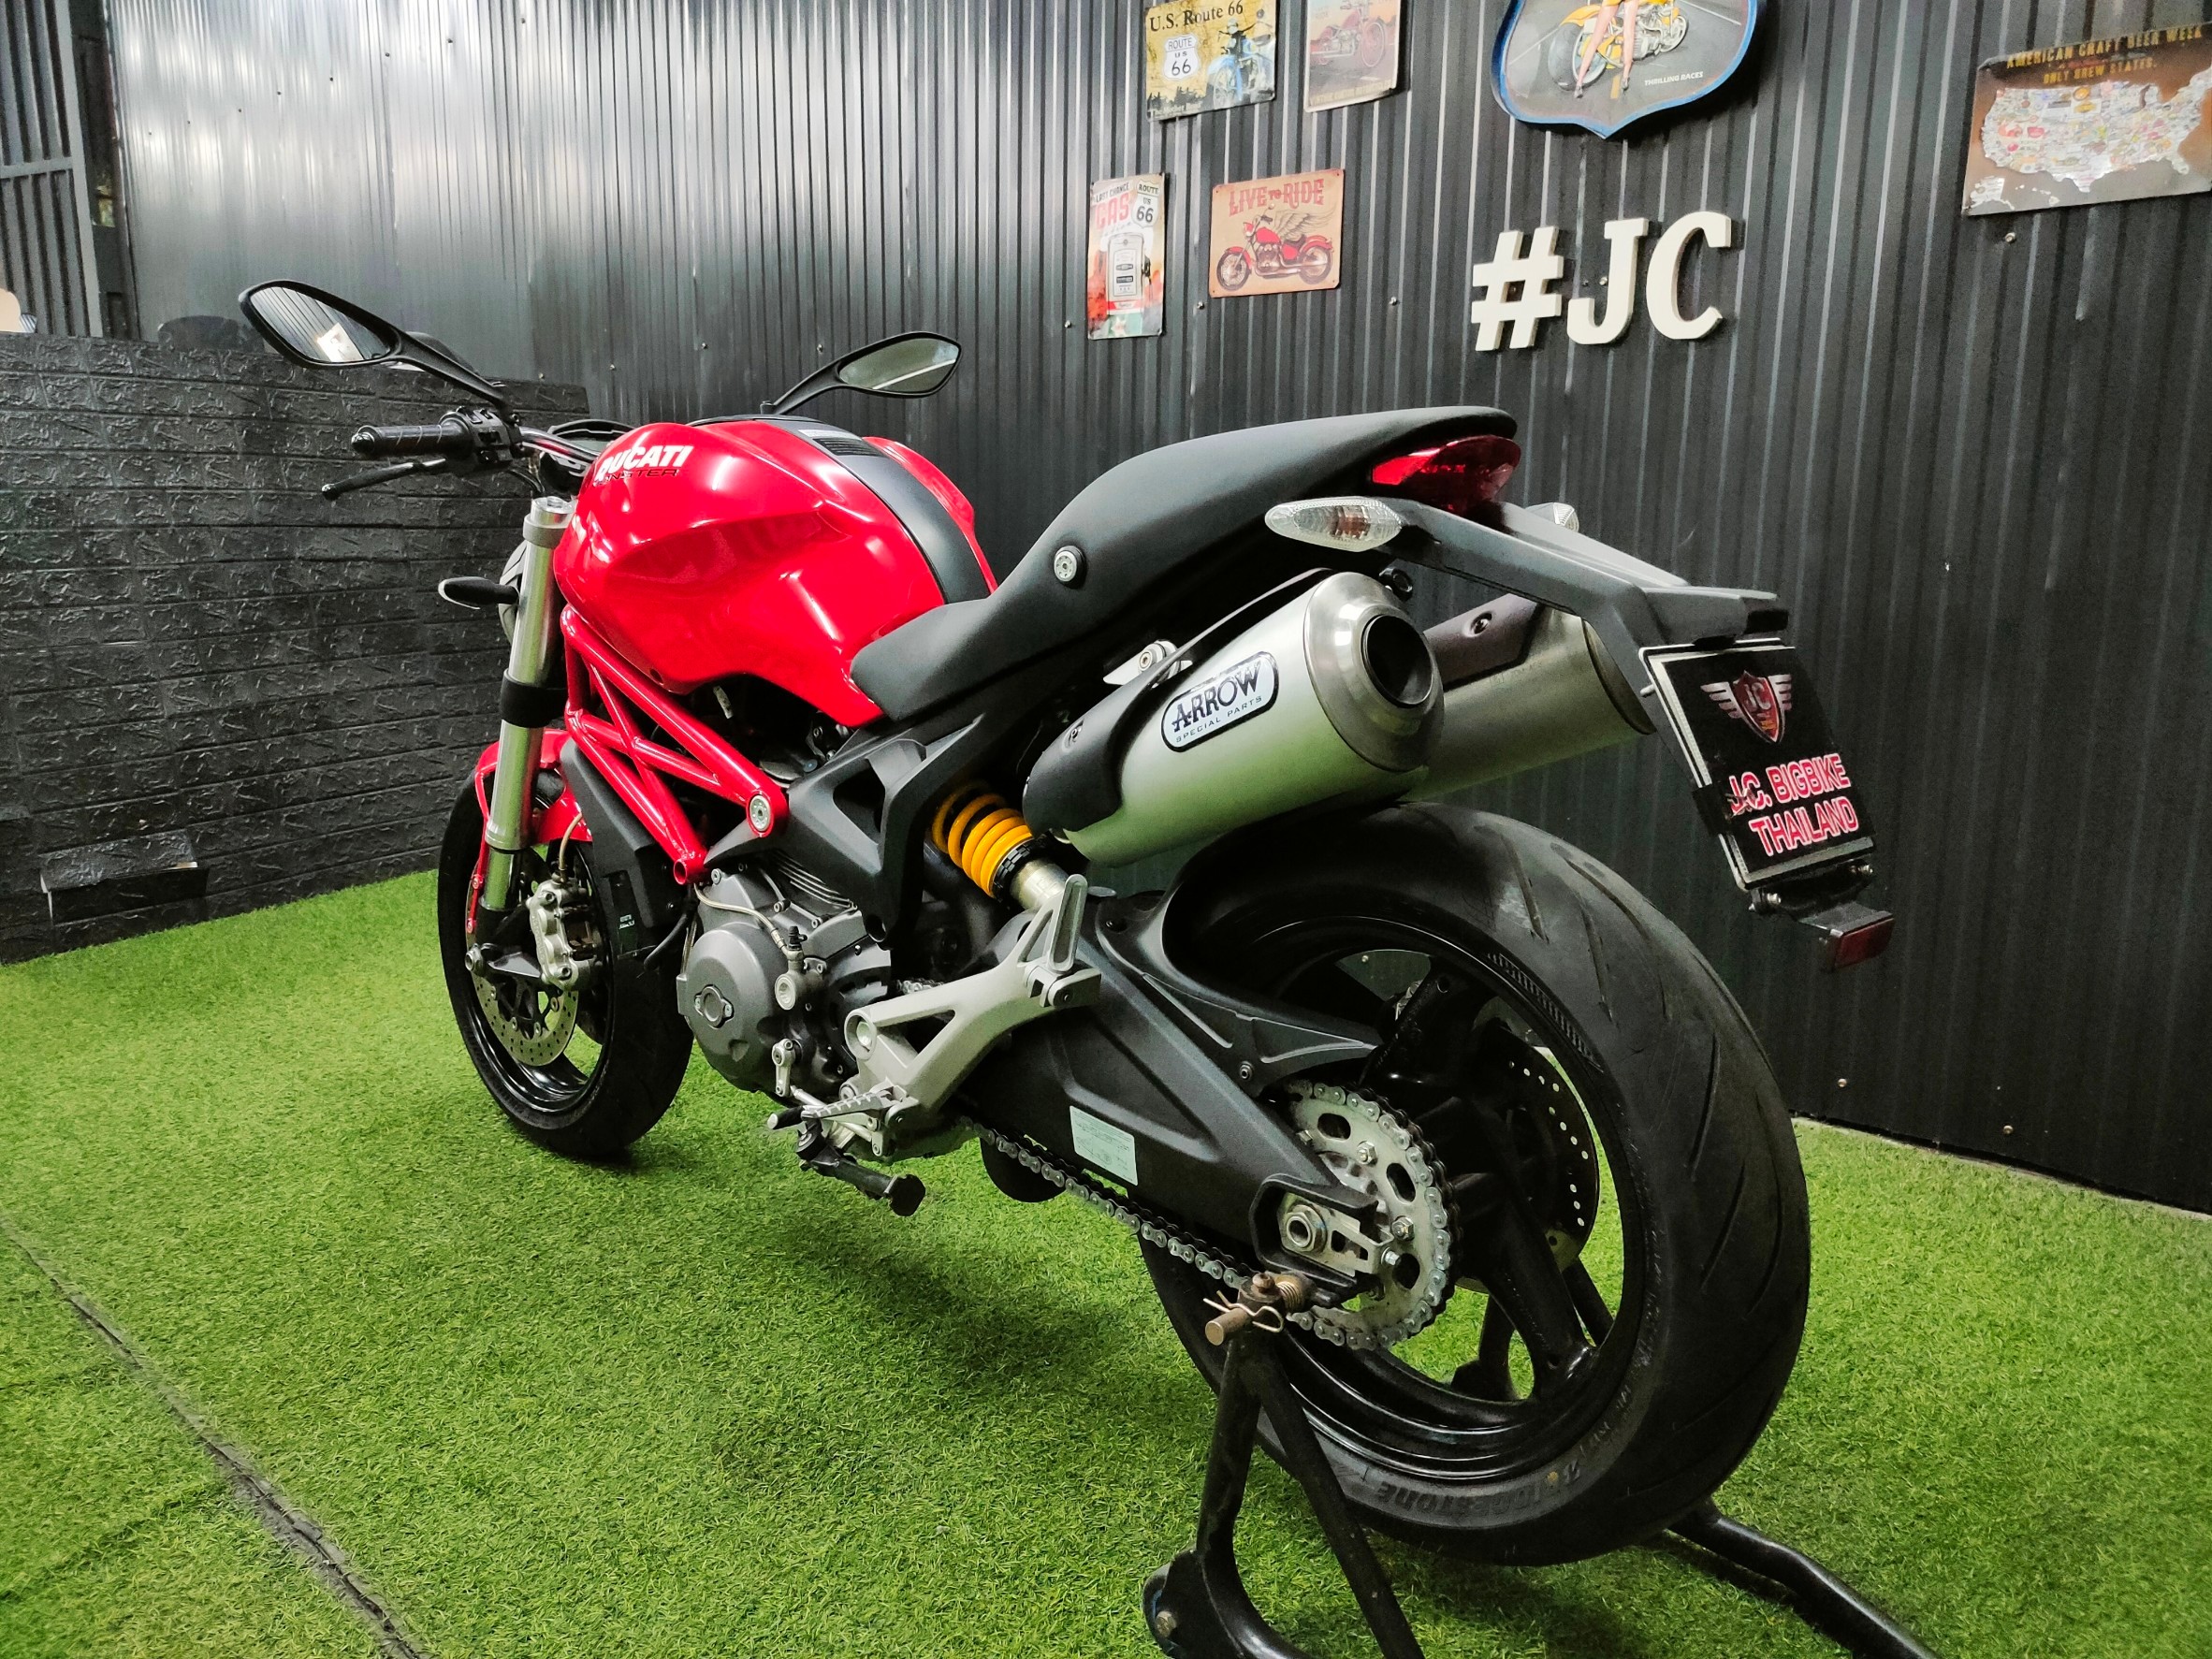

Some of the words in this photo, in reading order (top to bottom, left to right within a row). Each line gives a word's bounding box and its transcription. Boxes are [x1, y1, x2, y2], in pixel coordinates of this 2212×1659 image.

[1150, 13, 1179, 32] U.S.
[1183, 7, 1224, 27] Route
[1228, 0, 1244, 17] 66
[1168, 37, 1192, 50] ROUTE
[2006, 44, 2074, 69] AMERICAN
[2078, 36, 2120, 57] CRAFT
[2127, 31, 2160, 49] BEER
[1171, 59, 1192, 77] 66
[1644, 75, 1680, 87] THRILLING
[1681, 70, 1704, 81] RACES
[1139, 183, 1159, 195] ROUTE
[1229, 187, 1267, 217] LIVE
[1283, 179, 1324, 209] RIDE
[1096, 193, 1129, 230] GAS
[1136, 206, 1154, 223] 66
[1471, 211, 1732, 351] #JC
[593, 445, 694, 483] DUCATI
[1171, 661, 1261, 733] ARROW
[1176, 718, 1221, 743] SPECIAL
[1227, 695, 1262, 717] PARTS
[1765, 753, 1851, 803] BIGBIKE
[1749, 795, 1859, 856] THAILAND
